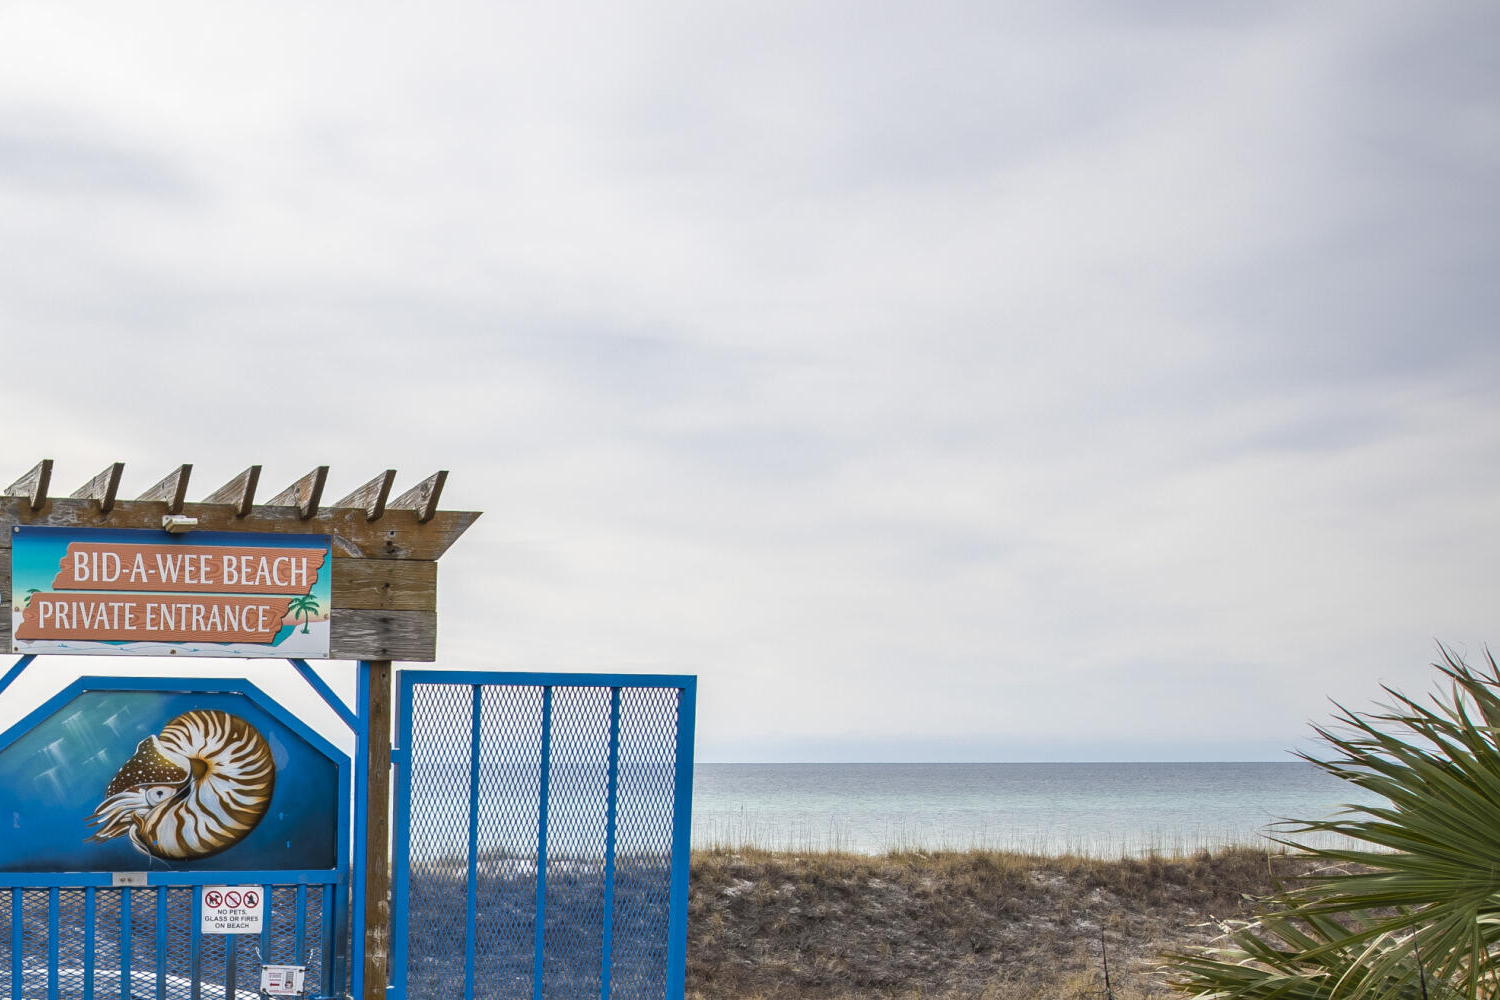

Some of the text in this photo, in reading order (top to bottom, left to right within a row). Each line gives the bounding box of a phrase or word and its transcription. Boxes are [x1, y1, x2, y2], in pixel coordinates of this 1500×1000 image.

[73, 551, 308, 587] BID-A-WEE BEACH
[38, 601, 271, 633] PRIVATE ENTRANCE
